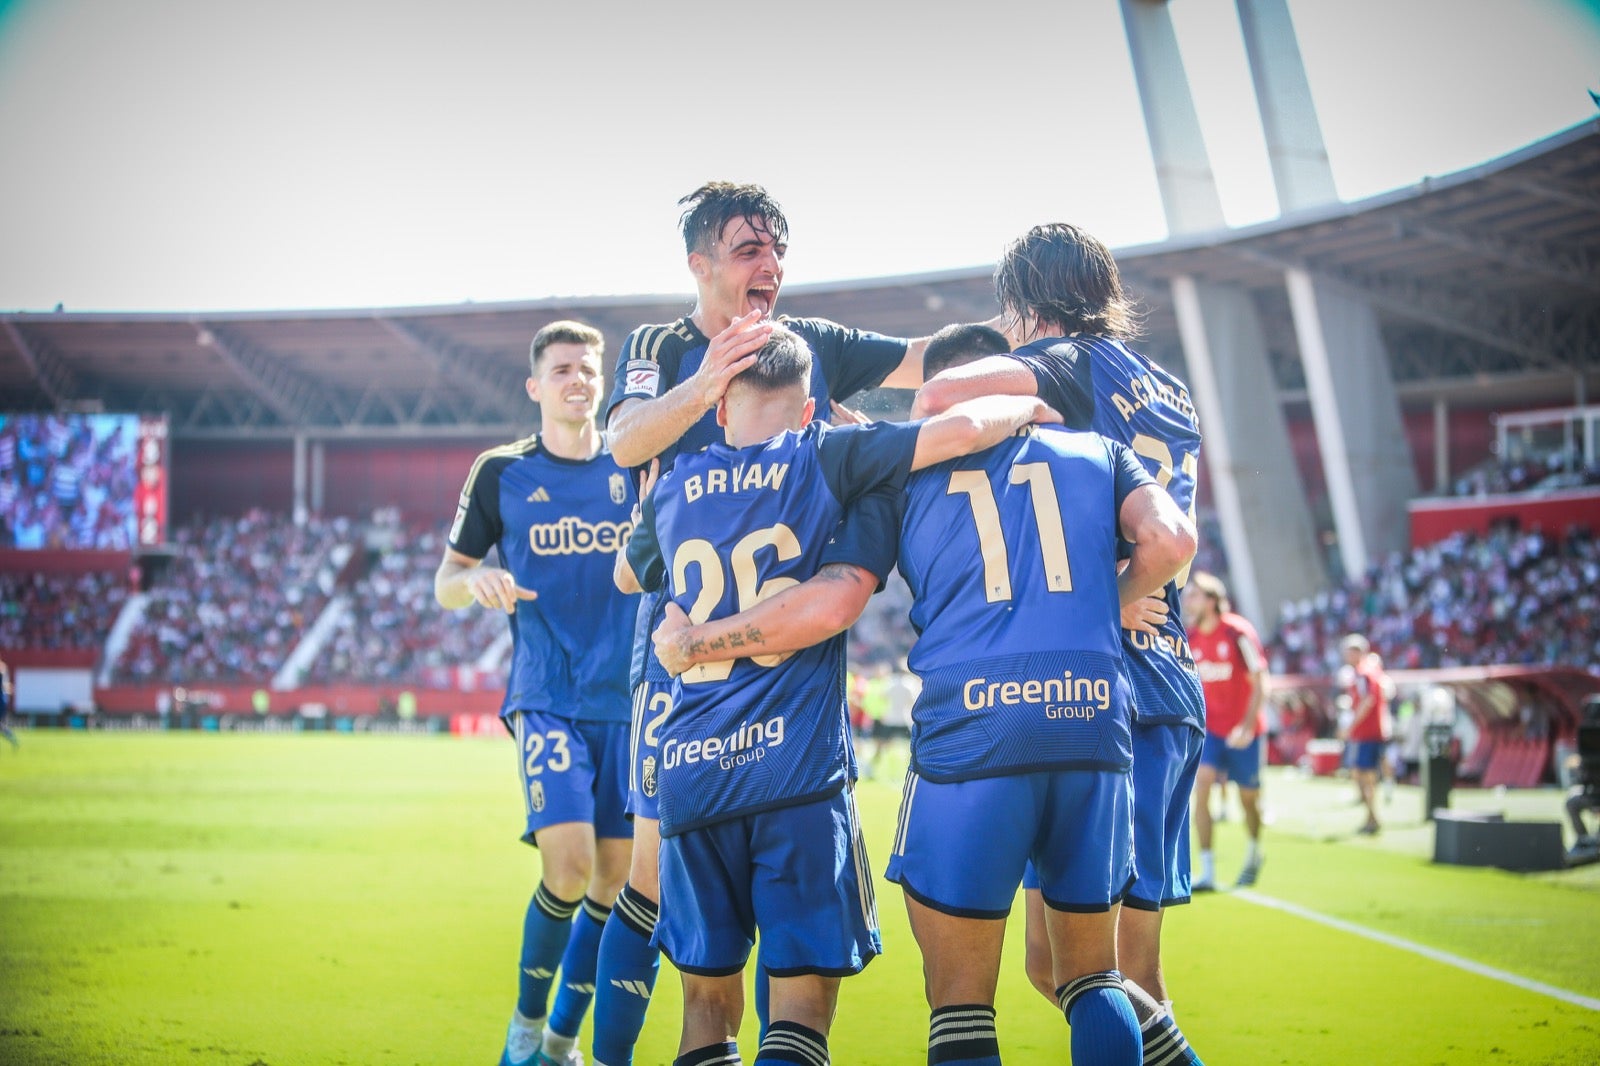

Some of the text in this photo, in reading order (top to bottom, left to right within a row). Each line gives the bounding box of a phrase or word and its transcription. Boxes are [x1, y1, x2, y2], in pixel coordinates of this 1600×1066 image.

[684, 462, 789, 504] BRYAN
[529, 516, 633, 556] wiber
[946, 462, 1073, 603] 11
[672, 523, 802, 684] 26
[963, 670, 1110, 711] Greening
[1045, 704, 1095, 722] Group
[525, 730, 571, 777] 23
[663, 716, 784, 770] Greening
[719, 746, 766, 770] Group
